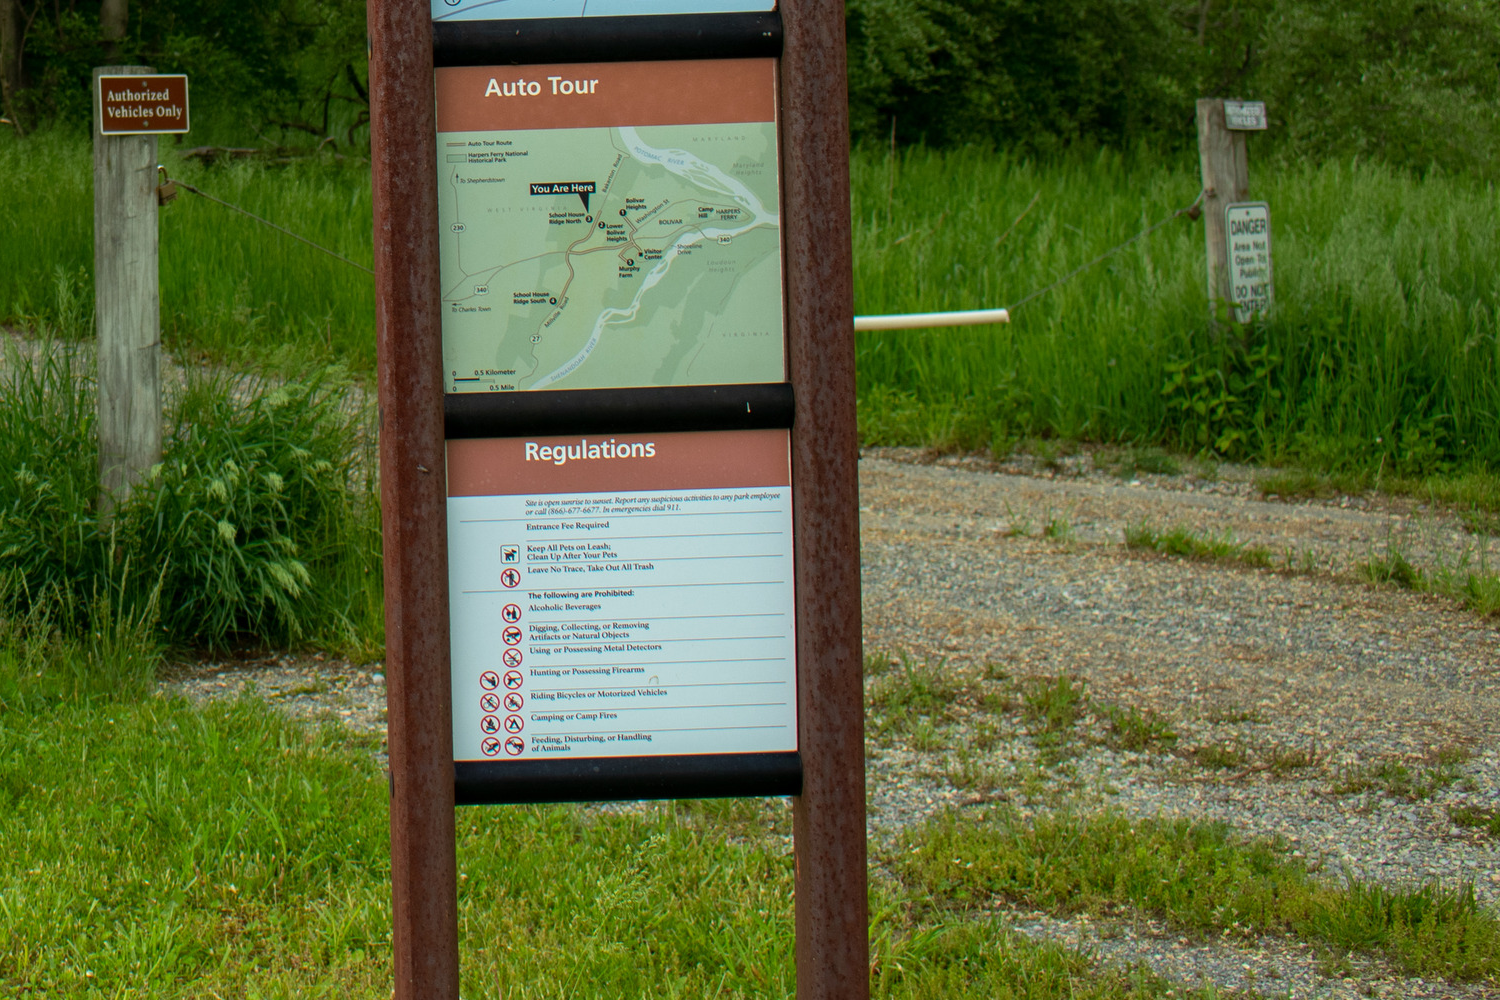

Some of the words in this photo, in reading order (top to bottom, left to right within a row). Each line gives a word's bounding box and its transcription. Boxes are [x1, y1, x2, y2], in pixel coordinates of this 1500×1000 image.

[484, 78, 541, 97] Auto
[547, 76, 599, 96] Tour
[107, 88, 170, 102] Authorized
[107, 105, 154, 118] Vehicles
[156, 104, 183, 120] Only
[531, 185, 550, 193] You
[552, 184, 569, 193] Are
[571, 183, 594, 192] Here
[1230, 218, 1266, 236] DANGER
[1234, 241, 1250, 252] Area
[1252, 240, 1266, 250] Not
[1235, 285, 1248, 298] DO
[1250, 283, 1269, 297] NOT
[525, 439, 656, 465] Regulations
[611, 504, 651, 514] emergencies
[652, 504, 666, 512] dial
[666, 503, 681, 511] 911.
[526, 523, 560, 531] Entrance
[576, 521, 610, 530] Required
[527, 545, 546, 553] Keep
[547, 544, 558, 552] All
[527, 553, 549, 561] Clean
[550, 553, 561, 561] Up
[527, 566, 549, 574] Leave
[562, 565, 585, 573] Trace,
[586, 564, 604, 572] Take
[621, 563, 632, 571] All
[633, 562, 654, 570] Trash
[543, 591, 579, 600] following
[594, 589, 634, 598] Prohibited:
[528, 604, 563, 612] Alcoholic
[565, 603, 602, 612] Beverages
[529, 624, 559, 633] Digging,
[561, 623, 601, 632] Collecting,
[612, 621, 650, 630] Removing
[529, 633, 561, 641] Artifacts
[601, 631, 630, 640] Objects
[529, 646, 551, 655] Using
[563, 645, 602, 654] Possessing
[604, 644, 625, 652] Metal
[626, 643, 662, 651] Detectors
[530, 669, 561, 677] Hunting
[572, 667, 611, 676] Possessing
[612, 666, 645, 674] Firearms
[530, 692, 556, 701] Riding
[556, 691, 586, 700] Bicycles
[637, 688, 668, 696] Vehicles
[530, 714, 564, 722] Camping
[575, 712, 598, 721] Camp
[531, 736, 563, 744] Feeding,
[564, 735, 606, 743] Disturbing,
[617, 733, 652, 742] Handling
[540, 744, 571, 752] Animals
